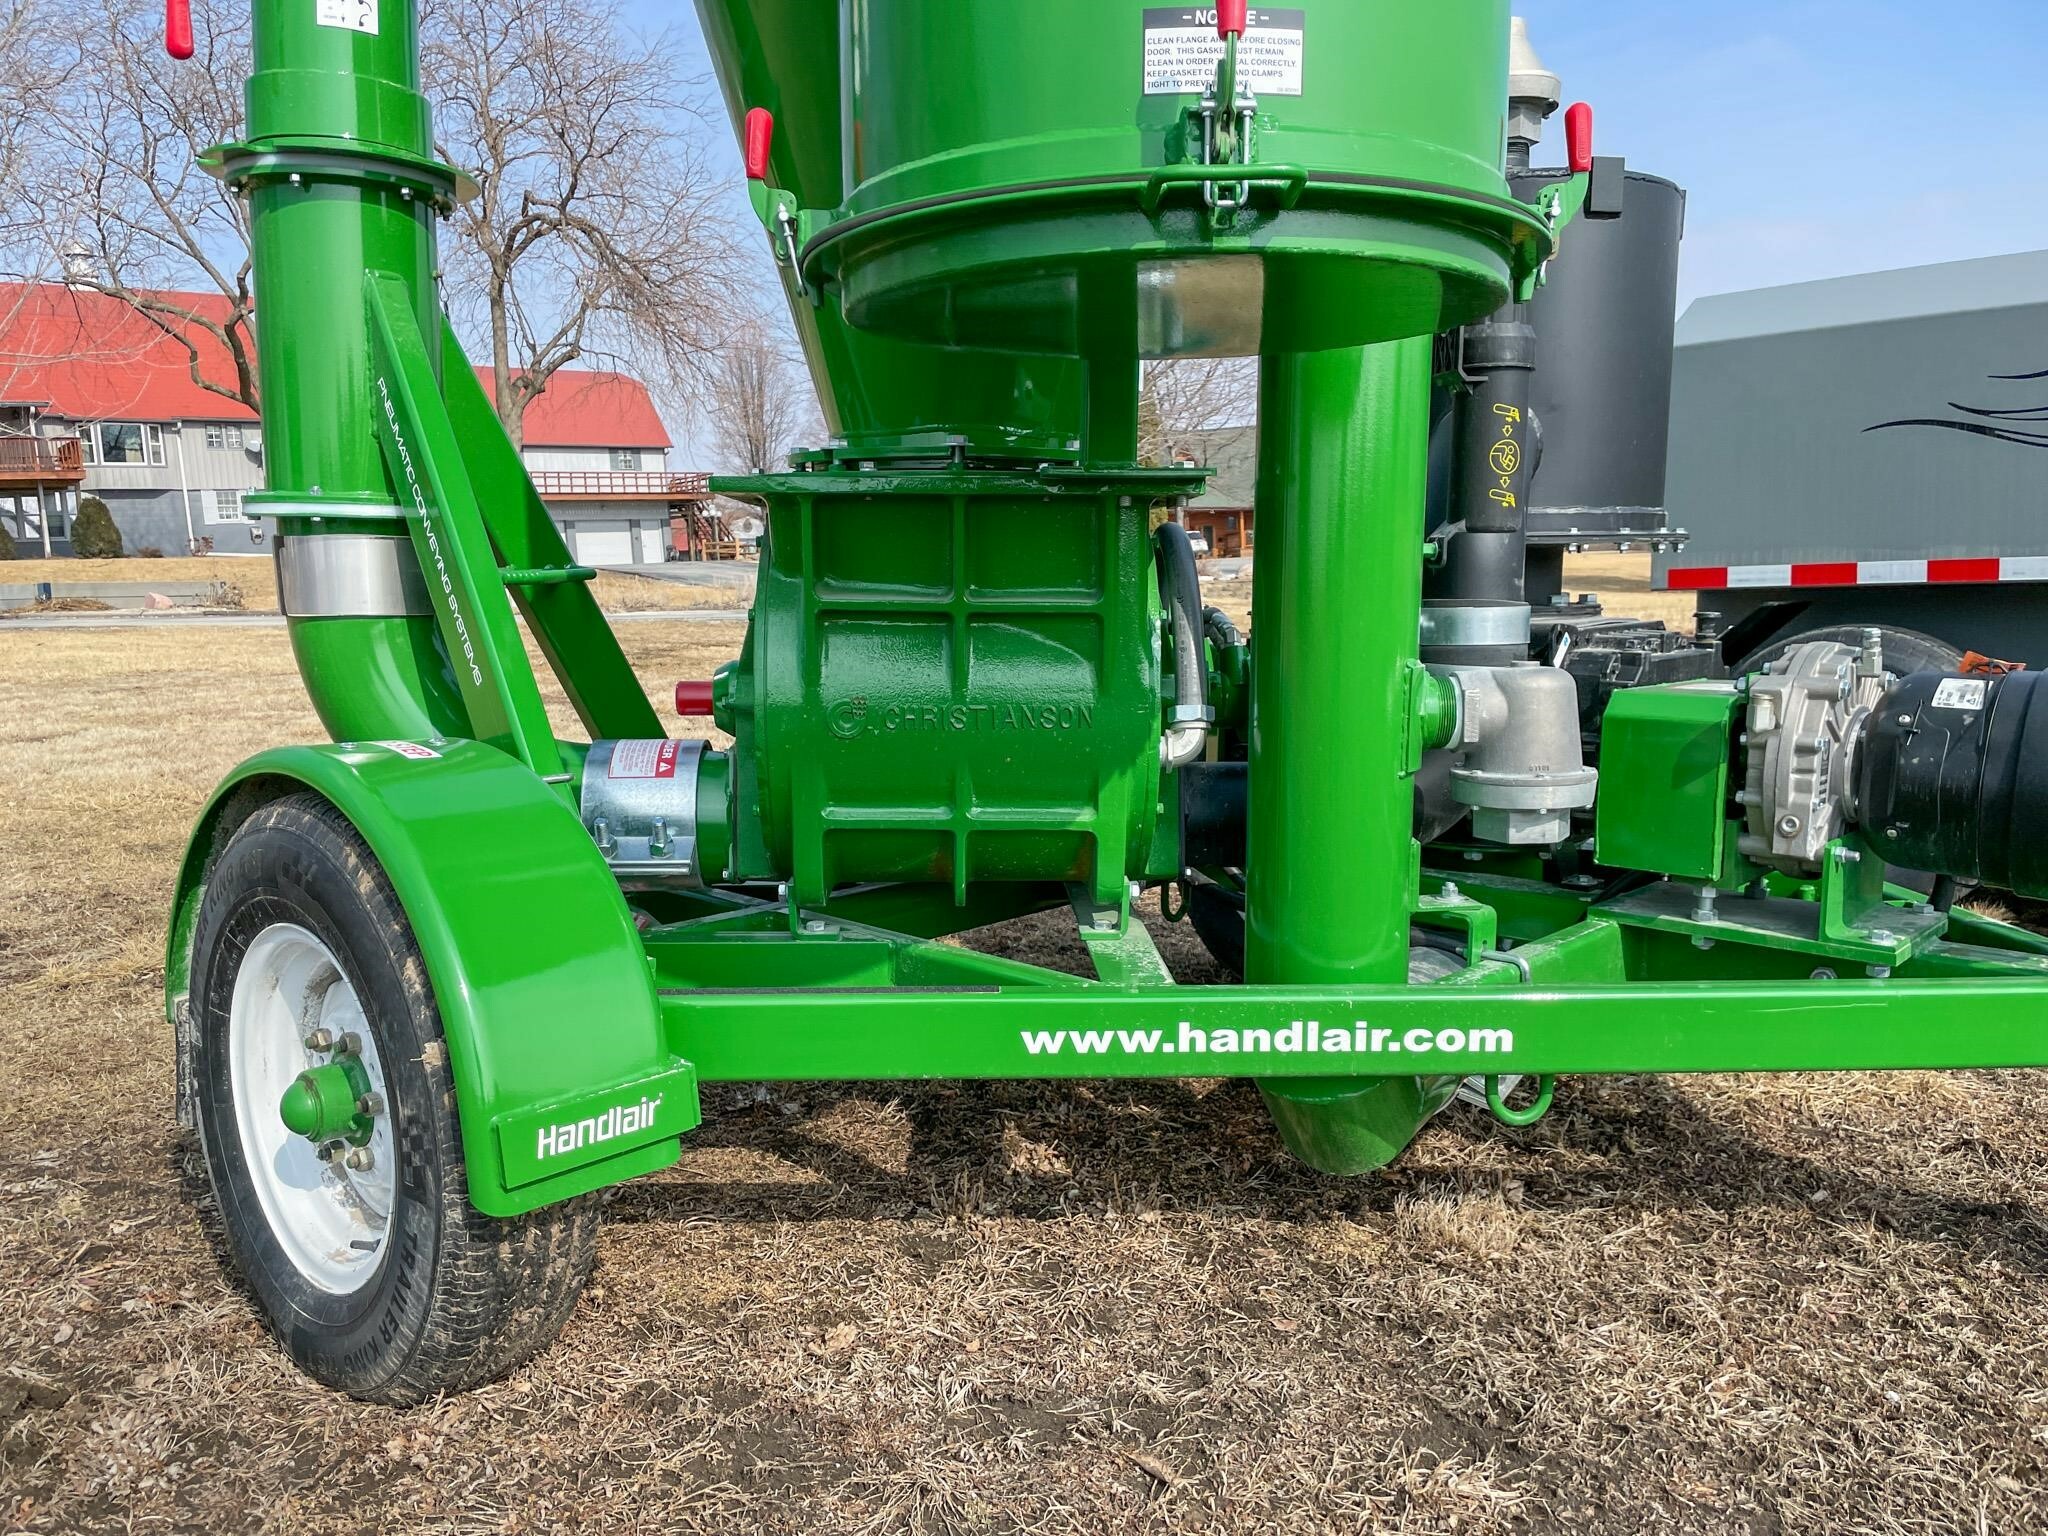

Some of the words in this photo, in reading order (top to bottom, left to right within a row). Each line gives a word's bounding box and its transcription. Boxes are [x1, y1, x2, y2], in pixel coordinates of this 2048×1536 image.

[1195, 9, 1257, 25] NOE
[1147, 37, 1174, 45] CLEAN
[1267, 37, 1301, 46] CLOSING
[1238, 47, 1253, 55] UST
[1254, 48, 1284, 56] REMAIN
[1146, 59, 1174, 67] CLEAN
[1146, 70, 1168, 78] KEEP
[1169, 69, 1203, 77] GASKET
[1251, 69, 1283, 77] CLAMPS
[1146, 80, 1170, 88] TIGHT
[377, 376, 416, 483] PNEUMATIC
[412, 483, 452, 594] CONVEYING
[448, 594, 482, 687] SYSTEMS
[884, 702, 1094, 730] CHRISTIANSON
[1020, 1020, 1514, 1055] www.handlair.com
[537, 1096, 661, 1160] Handlair
[379, 1228, 418, 1345] TRAILER
[344, 1335, 383, 1370] KING
